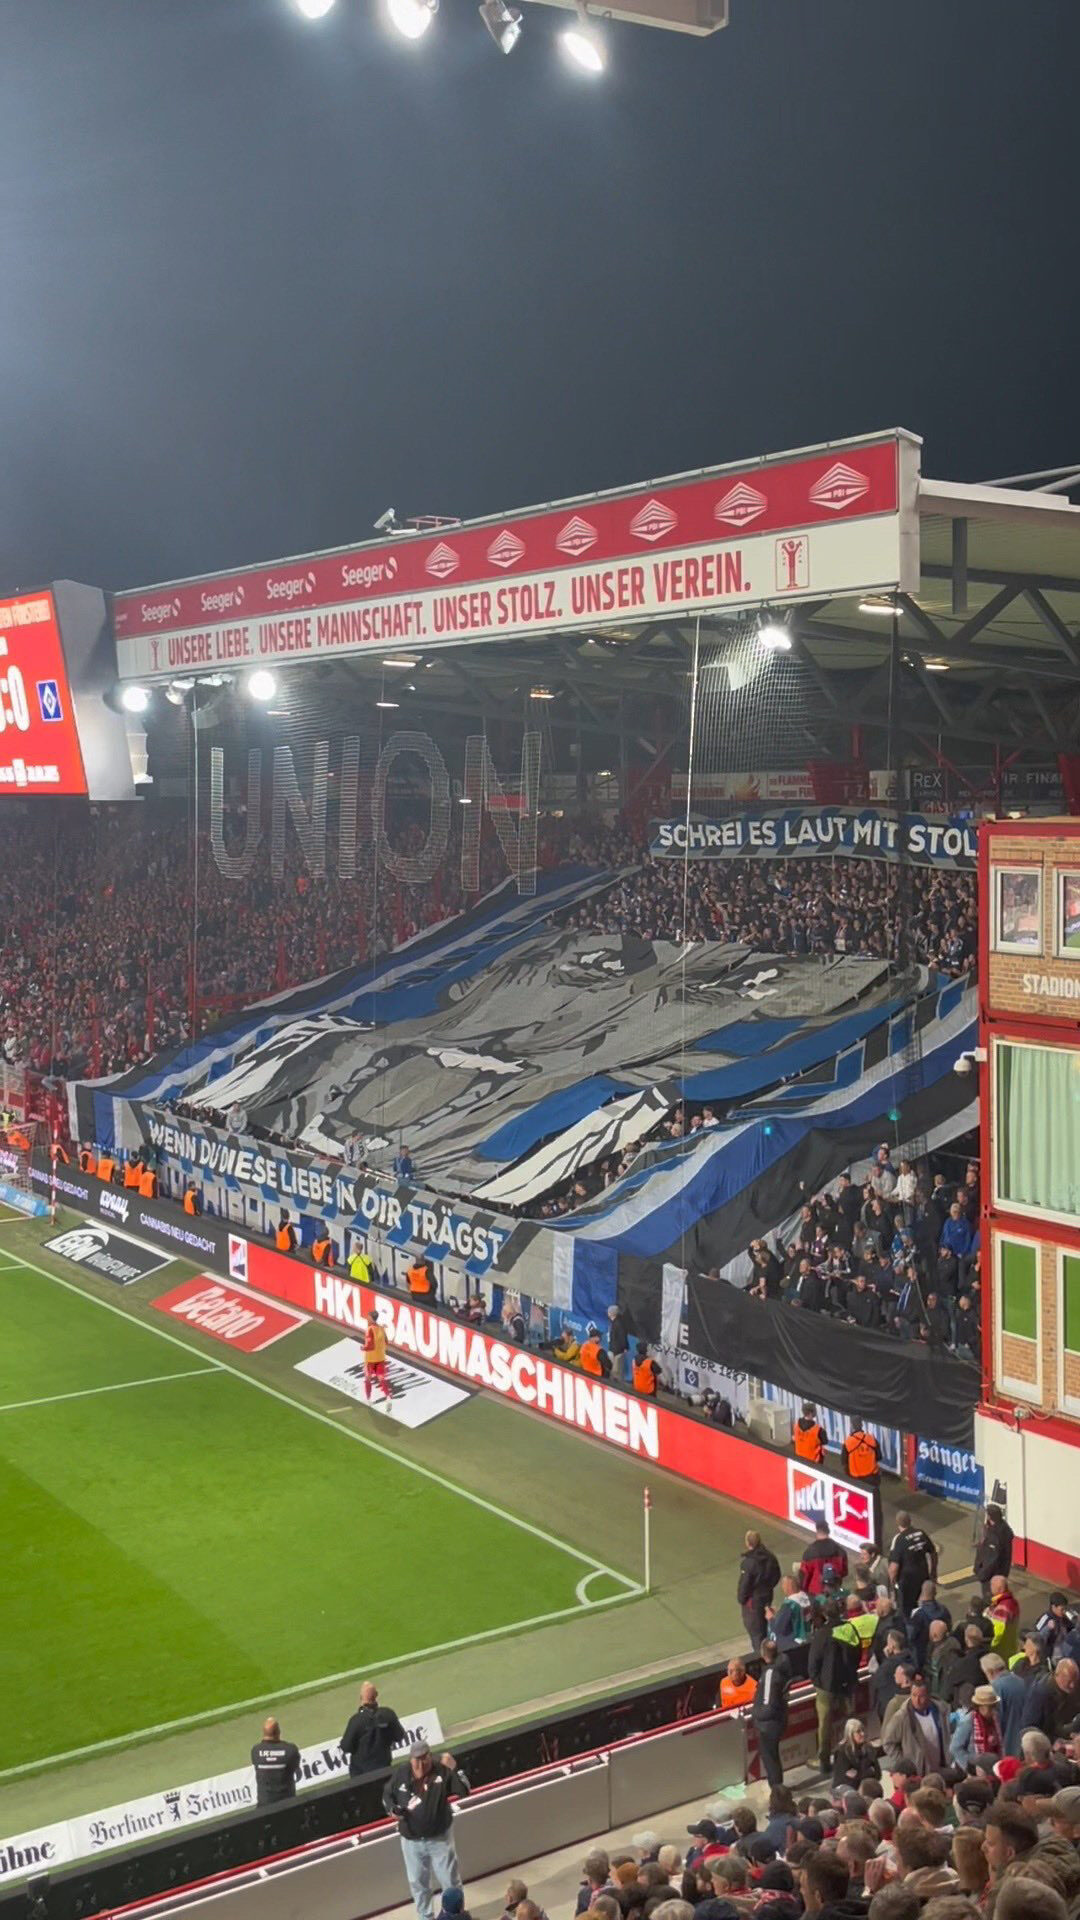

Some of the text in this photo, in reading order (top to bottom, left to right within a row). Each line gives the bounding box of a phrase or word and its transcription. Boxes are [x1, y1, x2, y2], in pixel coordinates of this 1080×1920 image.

[266, 578, 305, 600] Seeger
[342, 564, 385, 588] Seeger
[141, 603, 172, 623] Seeger
[168, 550, 752, 666] UNSERE LIEBE. UNSERE MANNSCHAFT. UNSER STOLZ. UNSER VEREIN.
[201, 591, 235, 613] Seeger
[210, 731, 542, 895] UNION
[659, 817, 979, 857] SCHREI ES LAUT MIT STOL
[149, 1120, 196, 1161] WENN
[199, 1139, 222, 1170] DU
[221, 1144, 278, 1188] DIESE
[280, 1164, 333, 1204] LIEBE
[336, 1178, 357, 1212] IN
[361, 1187, 403, 1230] DIR
[407, 1203, 503, 1265] TRÄGST
[171, 1285, 265, 1340] Betano
[314, 1271, 368, 1328] HKL
[375, 1294, 659, 1459] BAUMASCHINEN
[919, 1440, 978, 1474] sänger
[89, 1784, 253, 1848] Berliner Zeitung
